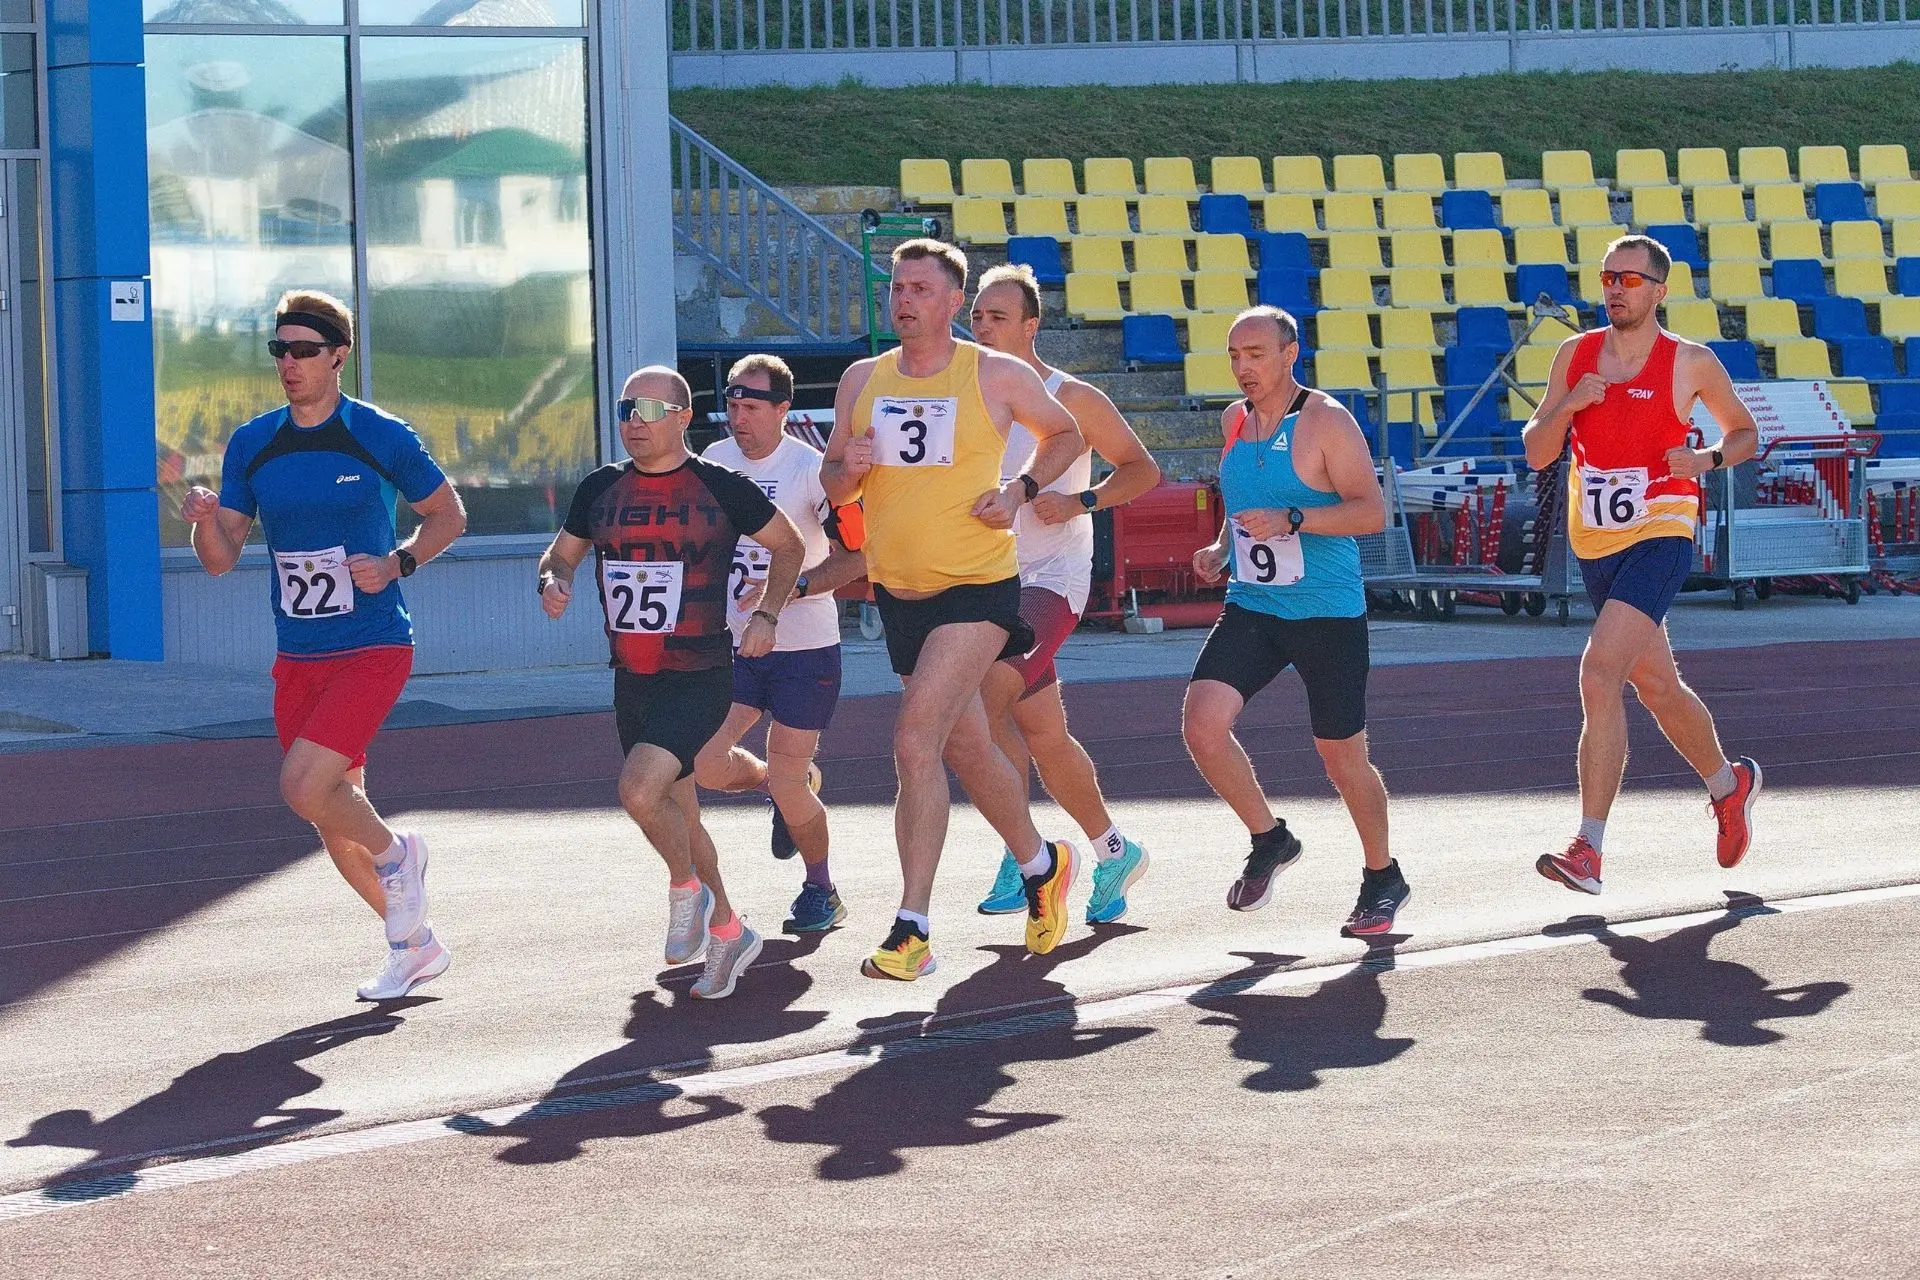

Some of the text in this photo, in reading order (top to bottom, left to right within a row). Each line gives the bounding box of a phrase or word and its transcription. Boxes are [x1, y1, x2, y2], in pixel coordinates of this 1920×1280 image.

[899, 420, 928, 464] 3
[1587, 487, 1635, 526] 16
[1249, 543, 1277, 583] 9
[287, 571, 341, 616] 22
[612, 584, 668, 631] 25
